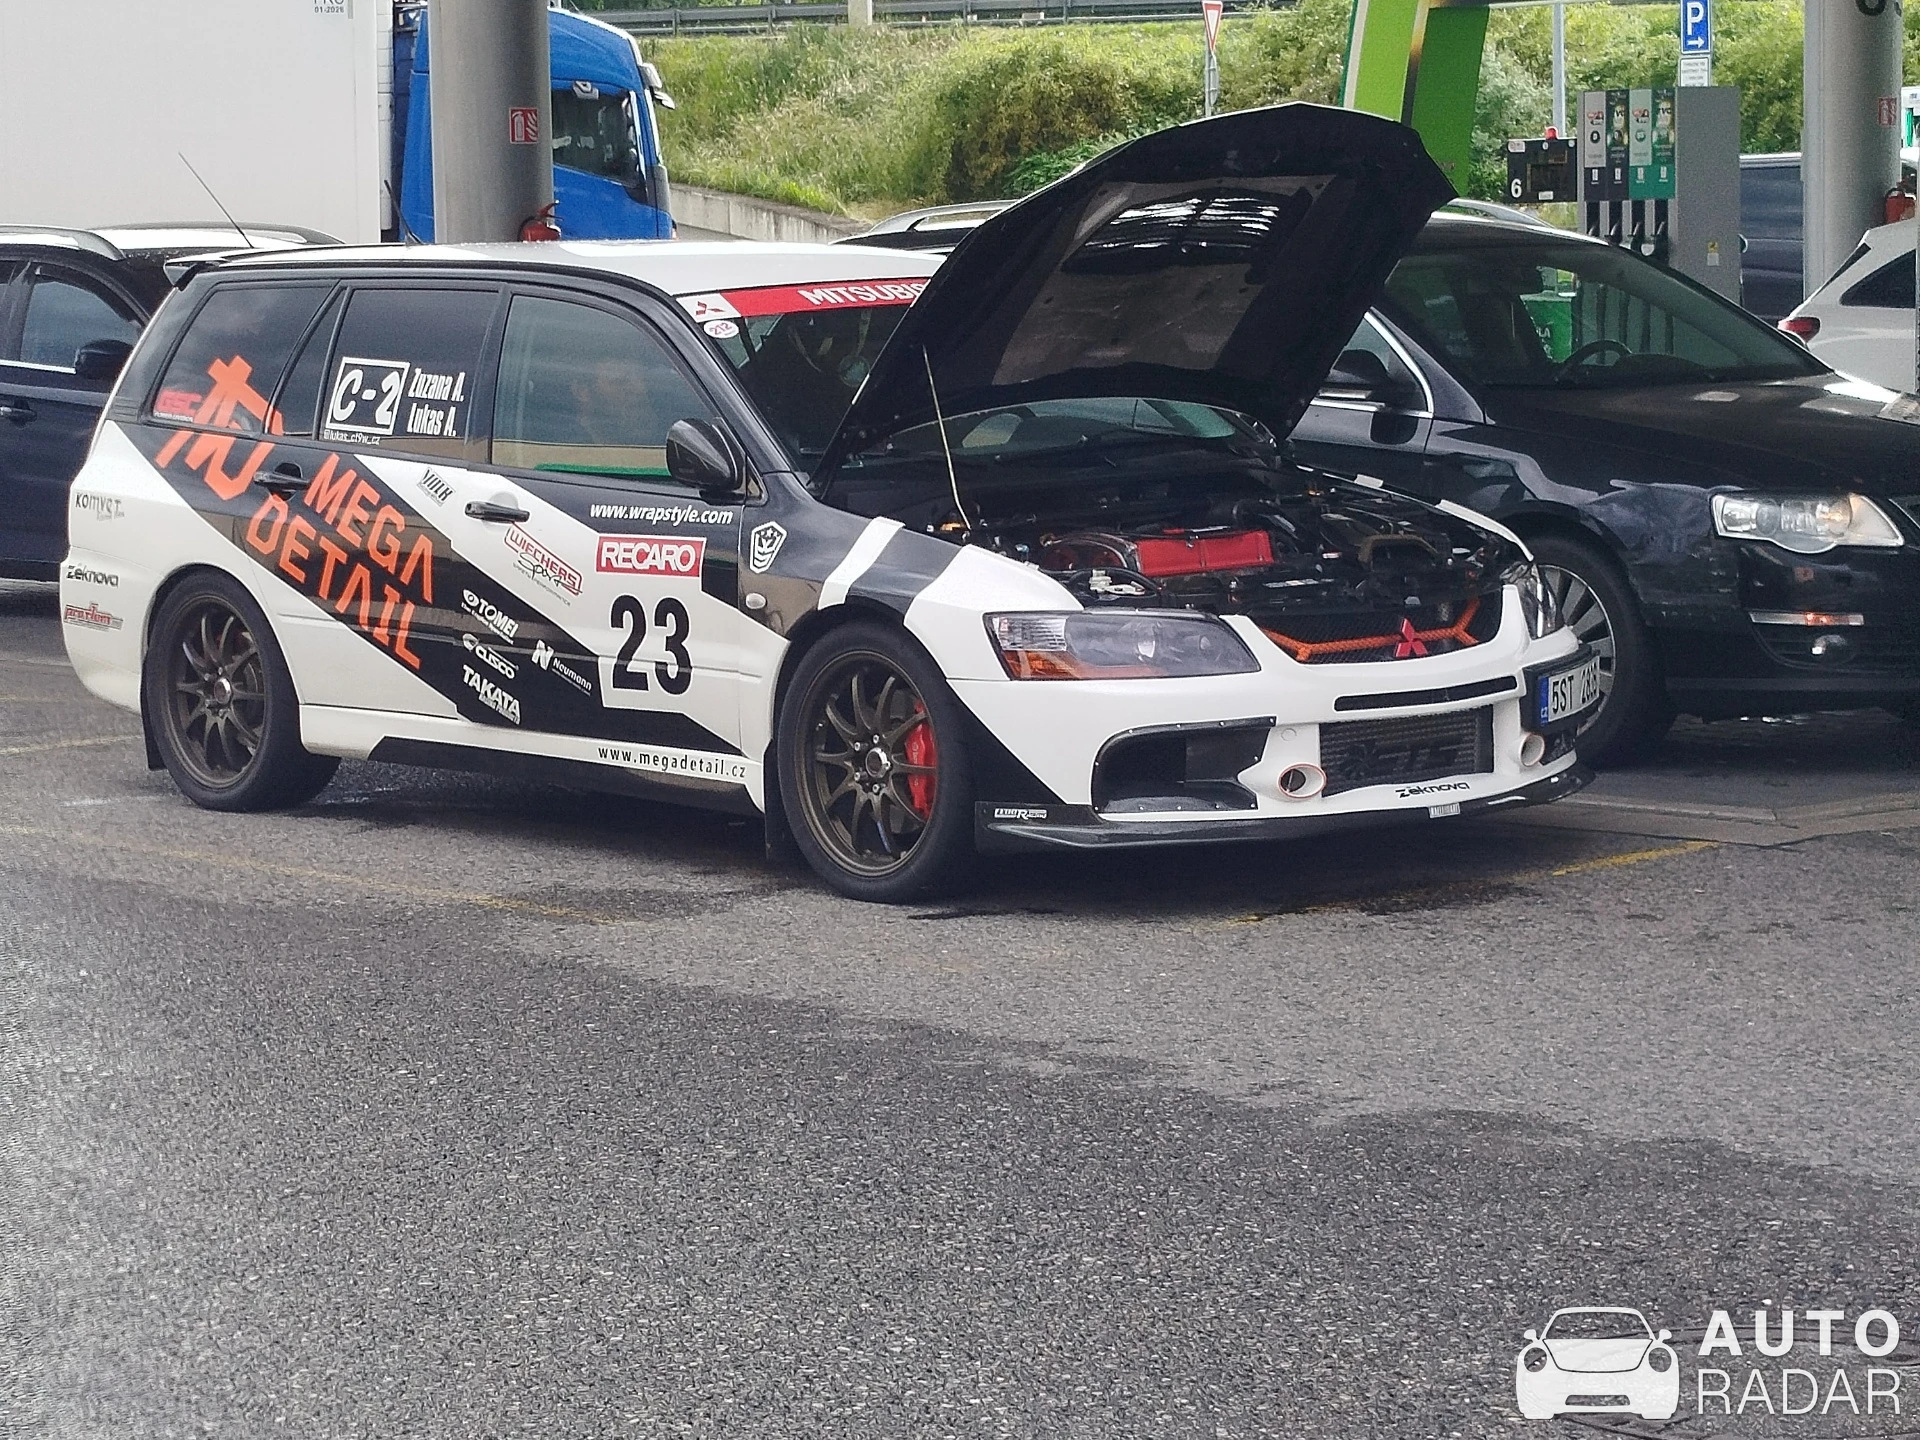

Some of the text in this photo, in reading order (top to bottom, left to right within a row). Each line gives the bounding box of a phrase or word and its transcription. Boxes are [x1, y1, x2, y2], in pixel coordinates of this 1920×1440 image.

[1687, 2, 1704, 36] P
[1511, 178, 1522, 198] 6
[332, 369, 400, 425] C-2
[408, 368, 466, 402] Zuzana A.
[407, 402, 457, 437] Lukas A.
[304, 452, 433, 604] MEGA
[590, 504, 734, 526] www.wrapstyle.com
[510, 529, 577, 589] WIECHERS
[600, 541, 696, 572] RECARO
[246, 493, 422, 670] DETAIL
[479, 598, 519, 638] TOMEI
[475, 645, 515, 679] CUSCO
[611, 594, 693, 695] 23
[463, 664, 520, 718] TAKATA
[553, 657, 592, 691] Neumann
[1552, 675, 1574, 714] 5ST
[598, 747, 746, 778] www.megadetail.cz
